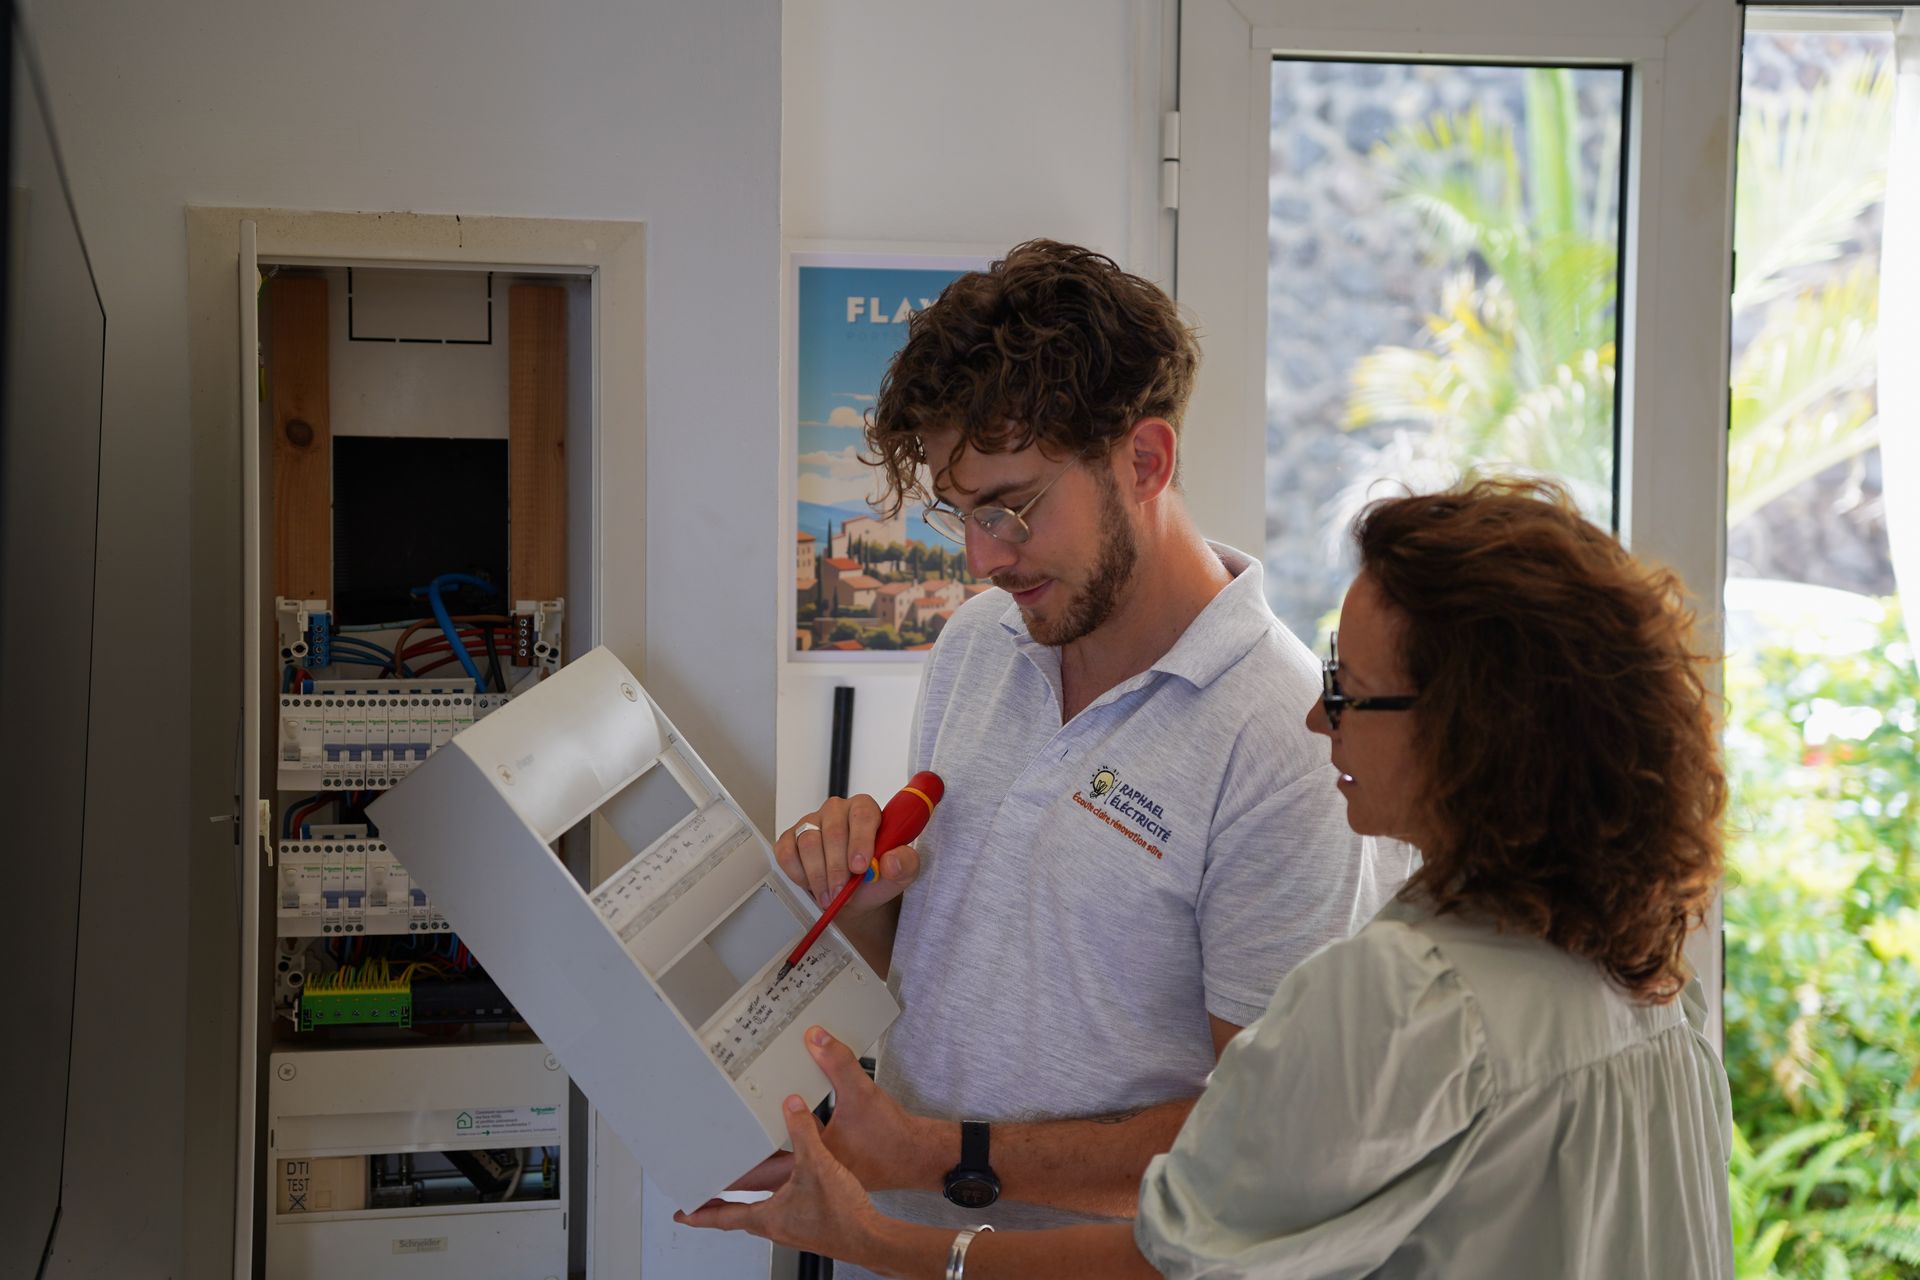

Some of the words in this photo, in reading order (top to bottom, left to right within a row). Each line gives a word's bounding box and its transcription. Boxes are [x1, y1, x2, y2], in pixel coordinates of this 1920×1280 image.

[1110, 795, 1172, 843] ÉLÉCTRICITÉ
[1119, 784, 1164, 819] RAPHAEL
[1072, 791, 1094, 812] Écoute
[1111, 820, 1148, 848] rénovation
[287, 1162, 309, 1175] DTI
[287, 1178, 309, 1192] TEST
